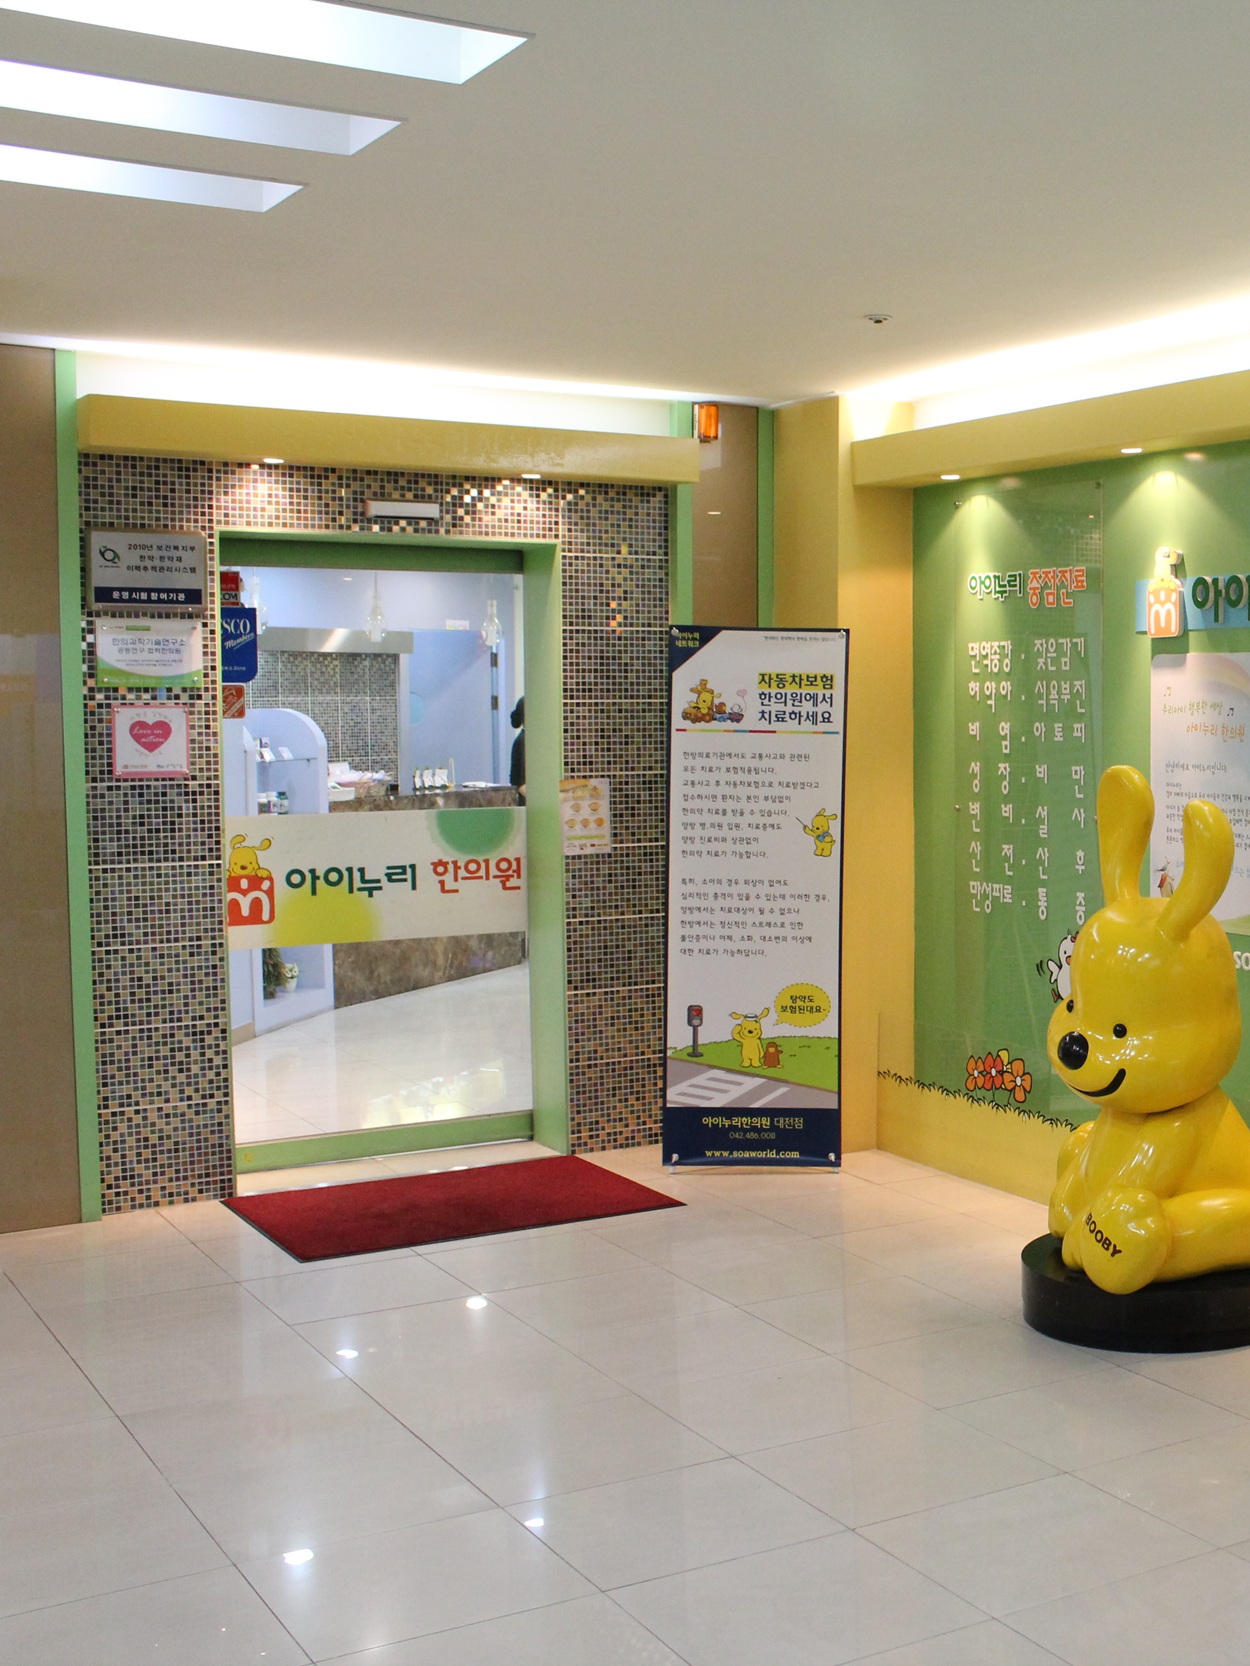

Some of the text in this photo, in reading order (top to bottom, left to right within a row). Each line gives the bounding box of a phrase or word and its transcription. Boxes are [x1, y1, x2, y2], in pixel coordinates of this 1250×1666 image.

[968, 567, 1087, 608] 아이누리 중점진료
[221, 619, 250, 634] SCO
[968, 640, 1012, 673] 면역증강
[758, 673, 834, 689] 자동차보험
[758, 691, 834, 708] 한의원에서
[1035, 680, 1085, 713] 식욕부진
[758, 710, 833, 725] 치료하세요
[683, 752, 810, 762] 한방의료기관에서도 교통사고와 관련된
[683, 766, 696, 774] 모든
[725, 767, 777, 775] 보험적용됩니다.
[682, 780, 710, 788] 교통사고
[725, 781, 773, 789] 자동차보험으로
[778, 781, 820, 790] 치료받겠다고
[682, 794, 718, 802] 접수하시면
[721, 794, 741, 802] 환자는
[682, 808, 703, 816] 한의약
[707, 808, 727, 816] 치료를
[681, 822, 696, 830] 양방
[748, 823, 782, 831] 치료중에도
[681, 836, 696, 844] 양방
[699, 836, 727, 844] 진료비와
[681, 850, 768, 859] 한의약 치료가 가능합니다.
[285, 856, 522, 898] 아이누리 한의원
[744, 879, 764, 887] 외상이
[680, 893, 709, 901] 심리적인
[713, 893, 734, 901] 충격이
[737, 893, 750, 901] 있을
[765, 894, 786, 902] 있는데
[790, 894, 811, 902] 이러한
[969, 881, 1012, 913] 만성피로
[680, 906, 716, 915] 양방에서는
[720, 907, 754, 915] 치료대상이
[759, 907, 764, 915] 될
[680, 920, 716, 929] 한방에서는
[719, 921, 747, 929] 정신적인
[790, 922, 803, 930] 인한
[680, 948, 694, 956] 대한
[790, 995, 815, 1003] 탕약도
[702, 1117, 803, 1128] 아이누리한의원 대전점
[705, 1149, 800, 1158] www.soaworld.com
